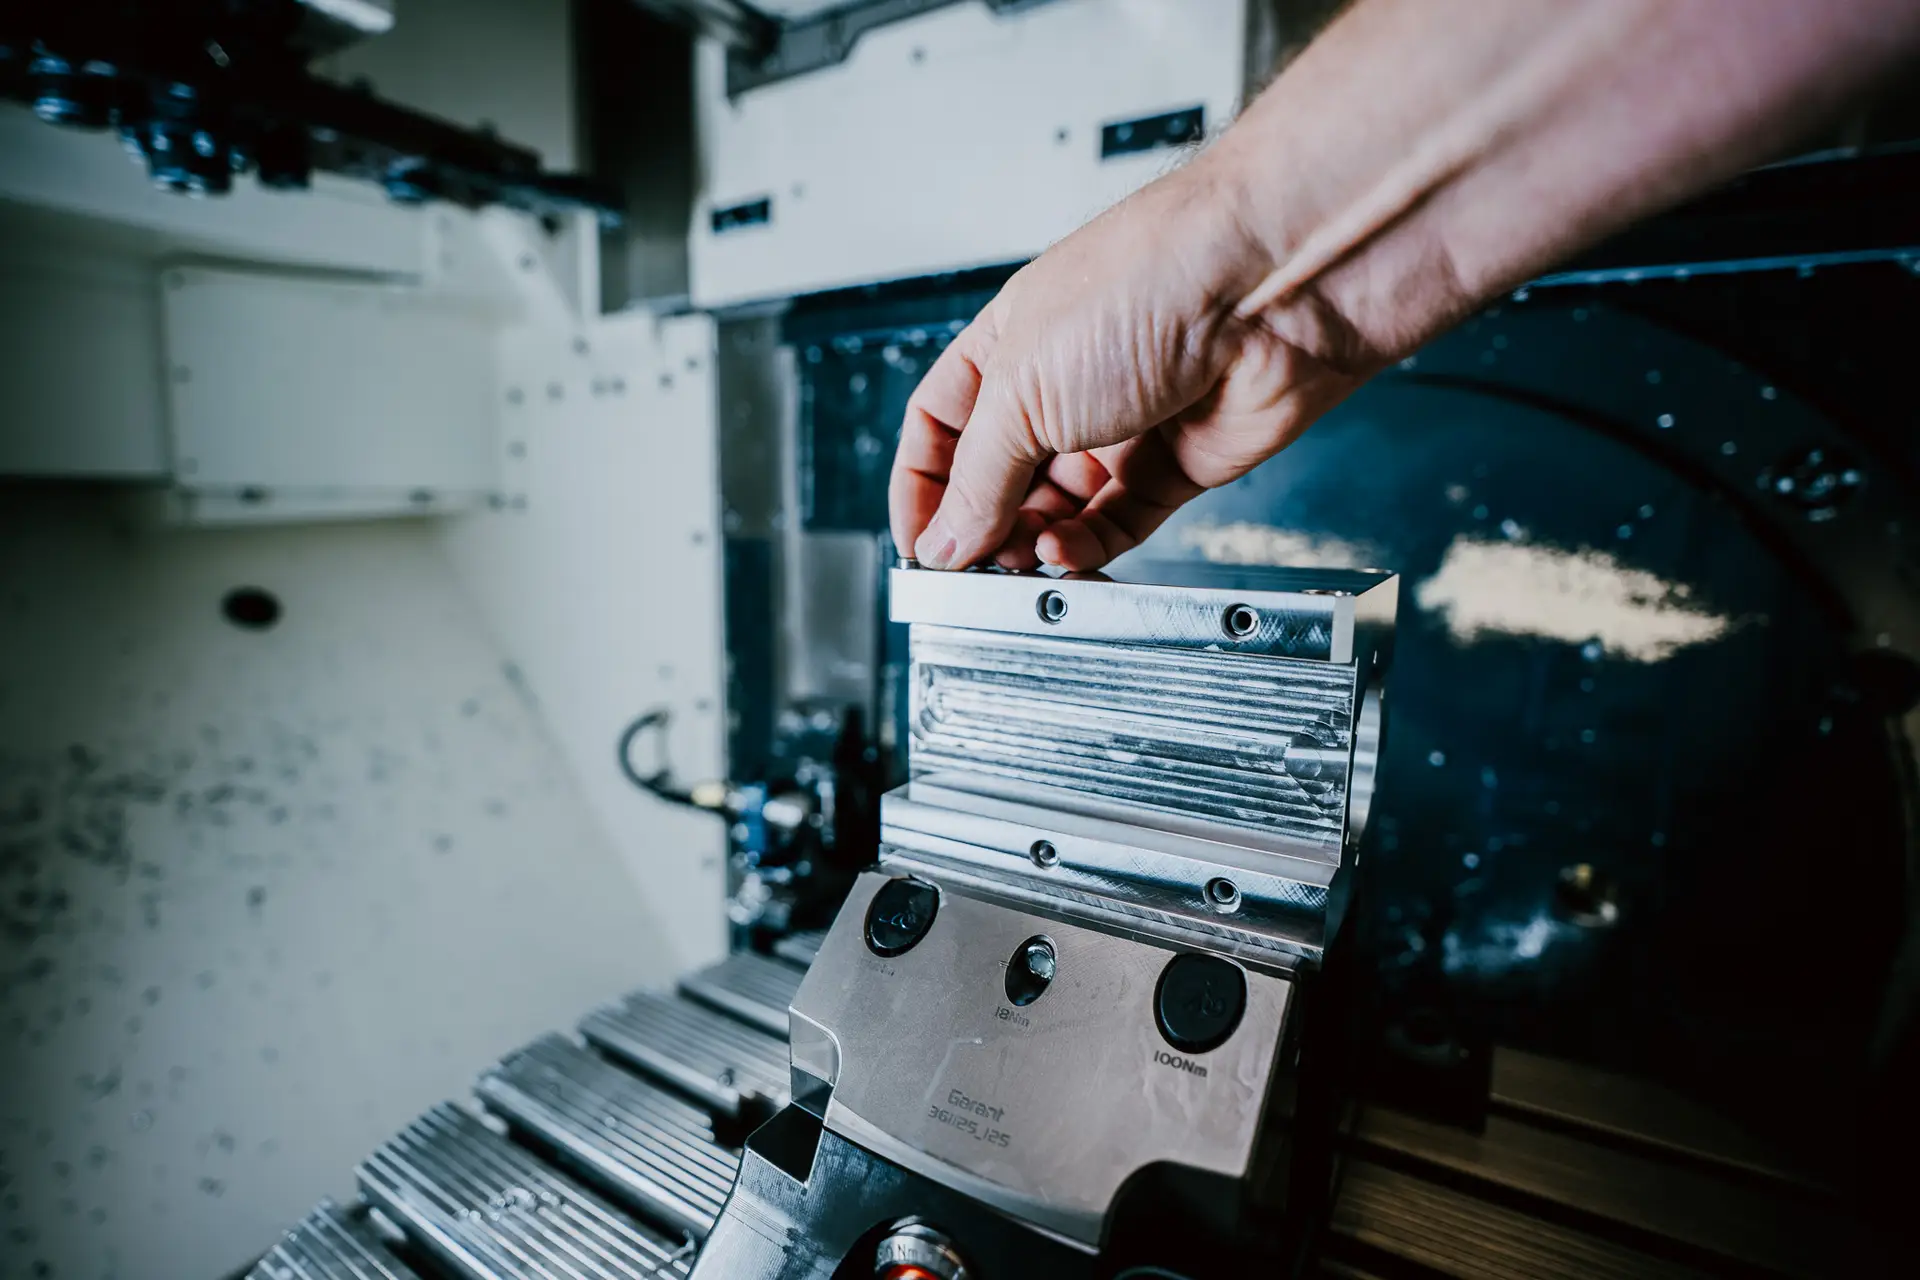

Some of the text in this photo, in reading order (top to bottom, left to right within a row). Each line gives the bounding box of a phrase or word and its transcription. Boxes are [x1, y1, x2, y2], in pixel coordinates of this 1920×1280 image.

[1154, 1050, 1208, 1078] 100Nm
[947, 1088, 1005, 1122] Garant
[927, 1104, 1011, 1148] 361125_125
[897, 1243, 918, 1258] Nm
